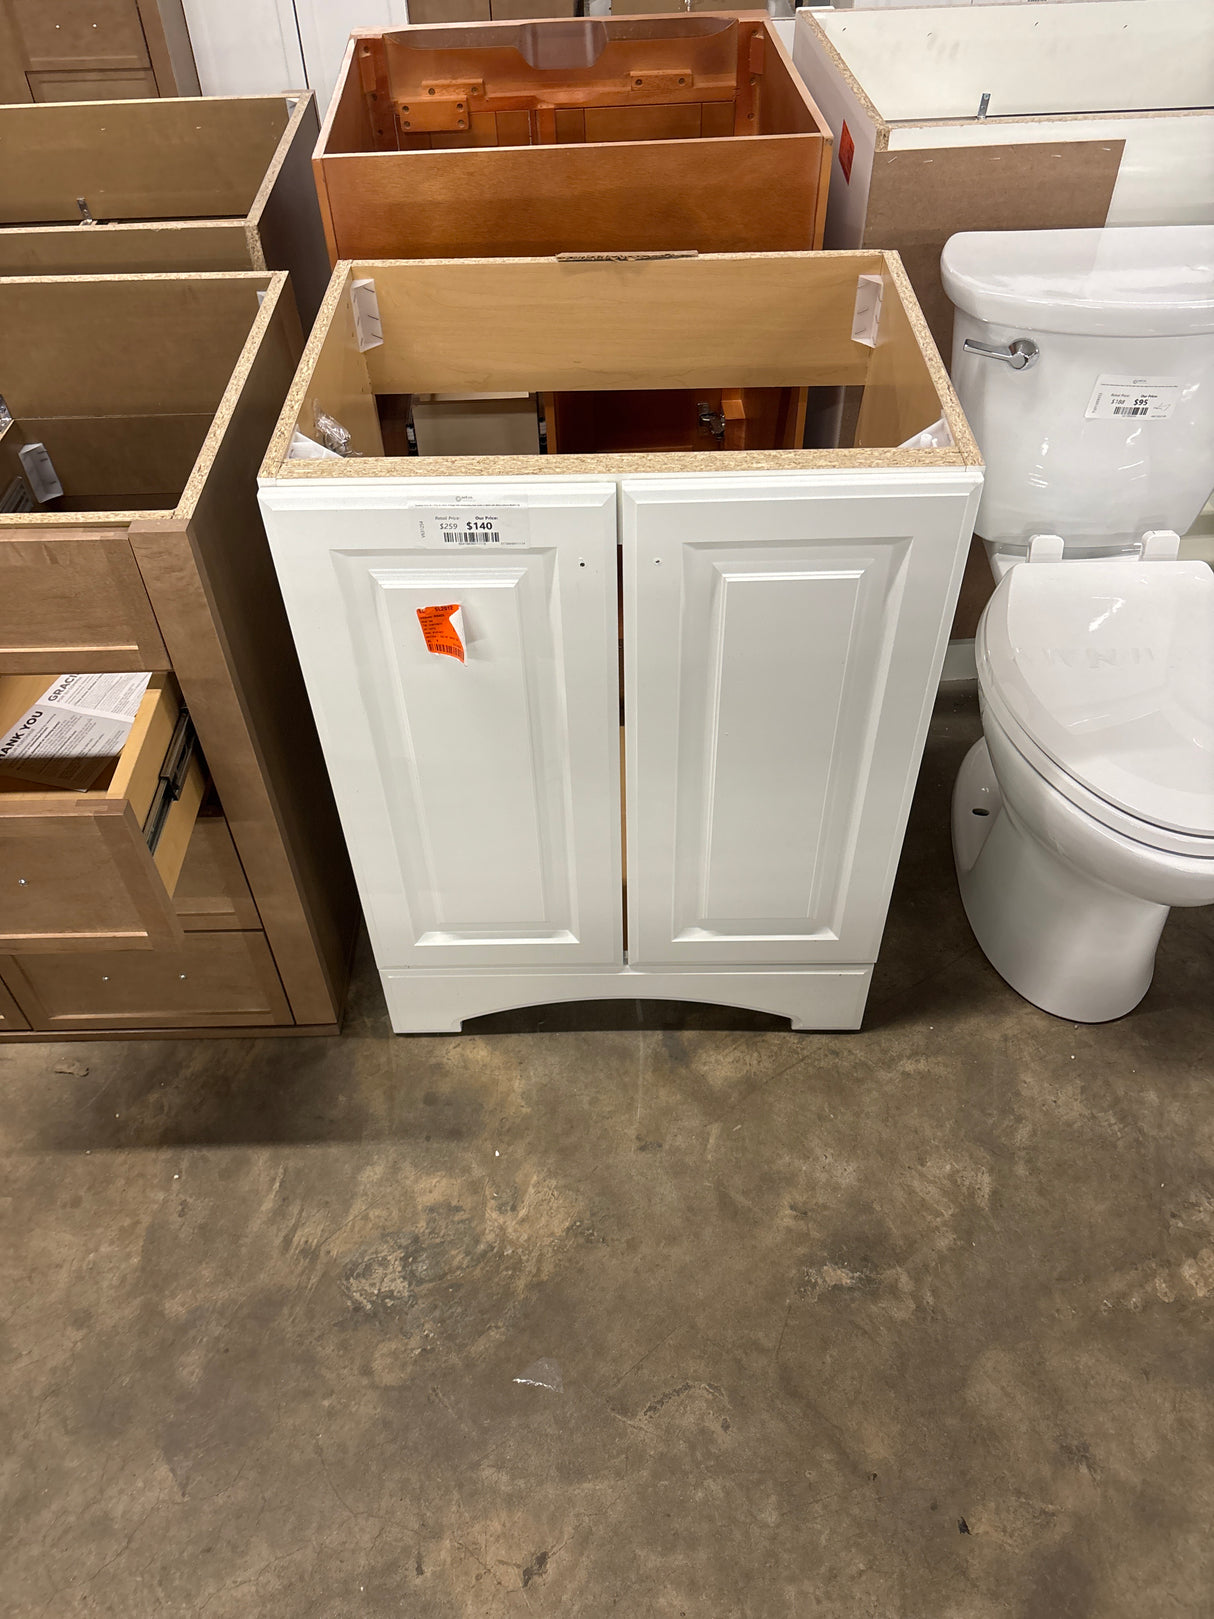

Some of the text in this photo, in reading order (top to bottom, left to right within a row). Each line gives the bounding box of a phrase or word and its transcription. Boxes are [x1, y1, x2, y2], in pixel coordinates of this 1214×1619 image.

[1133, 398, 1149, 406] $95
[439, 522, 458, 530] $259
[466, 521, 493, 530] $140
[48, 673, 80, 702] GRACI
[19, 711, 43, 730] YOU
